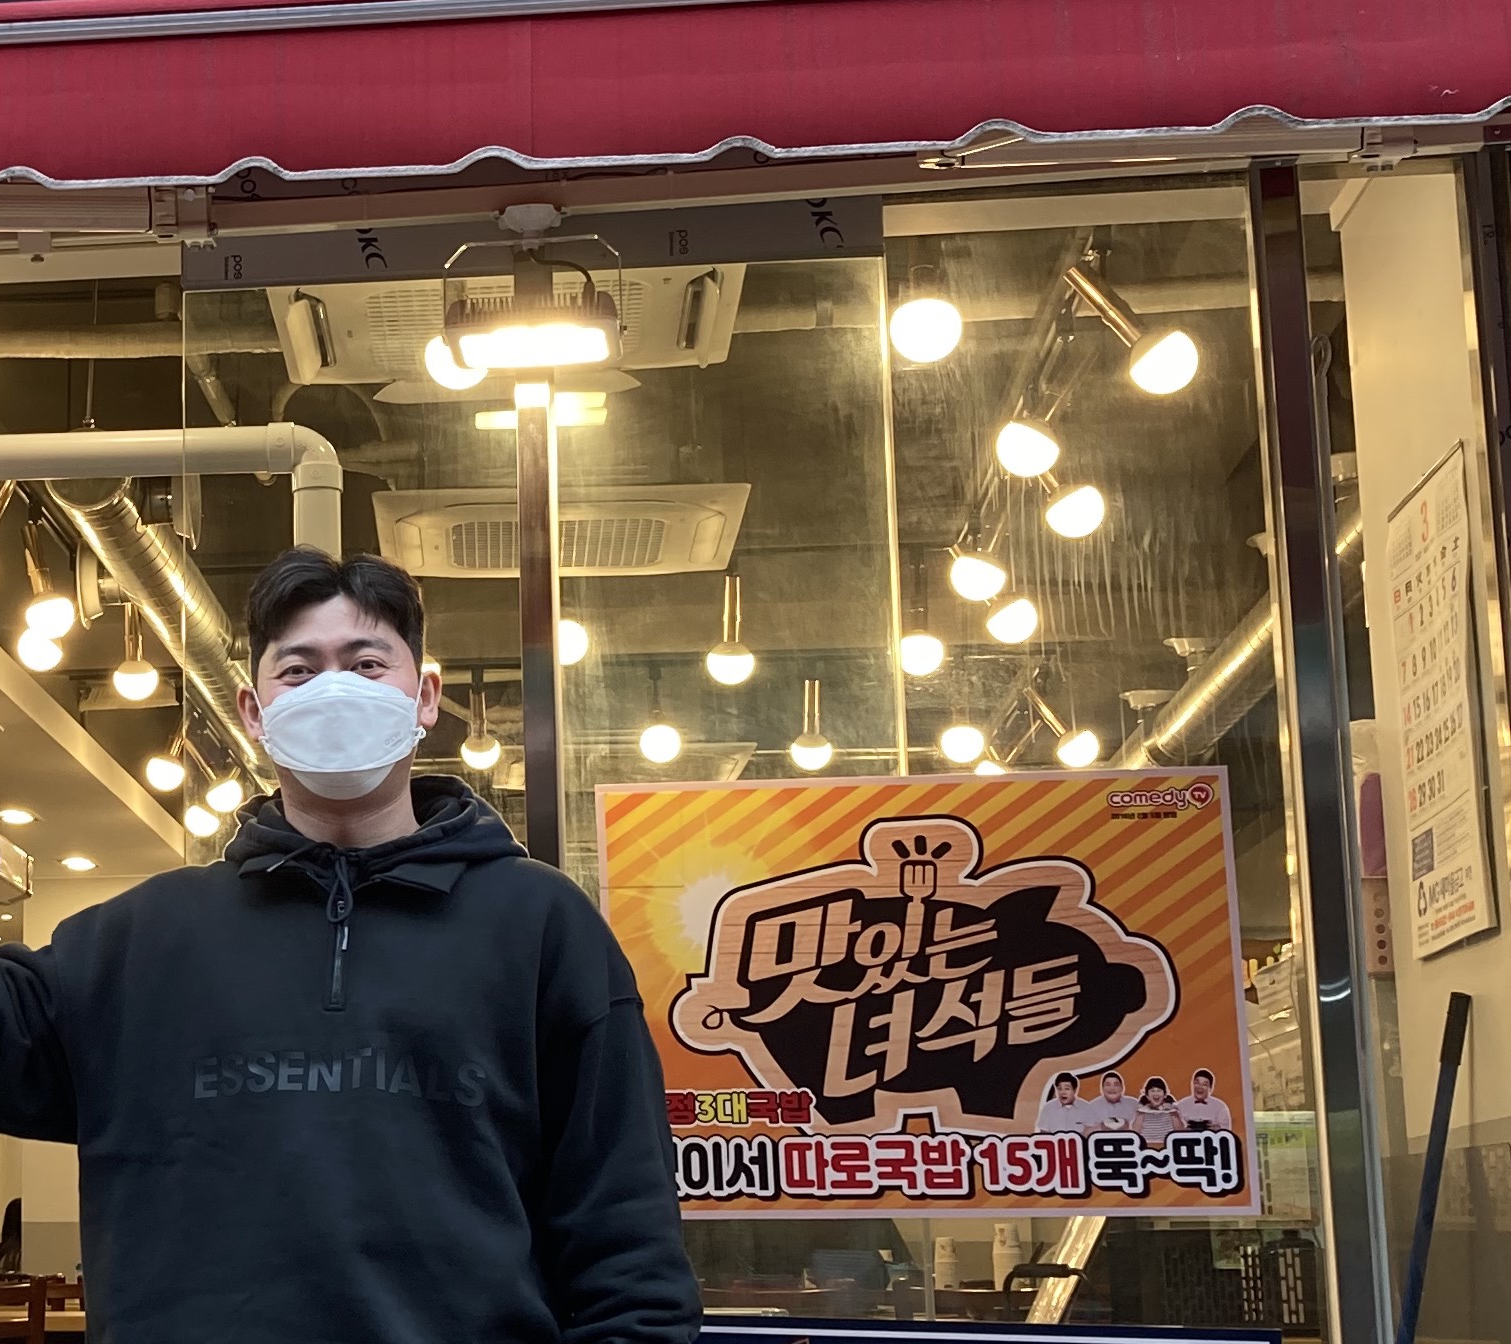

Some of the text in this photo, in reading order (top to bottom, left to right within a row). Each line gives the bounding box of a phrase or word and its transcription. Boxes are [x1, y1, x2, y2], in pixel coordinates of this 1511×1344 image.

[1109, 788, 1188, 809] comedy
[743, 889, 997, 1024] 맛있는
[824, 954, 1081, 1098] 녀석들
[194, 1047, 487, 1107] ESSENTIALS
[785, 1138, 965, 1193] 따로국밥
[982, 1137, 1081, 1191] 15개
